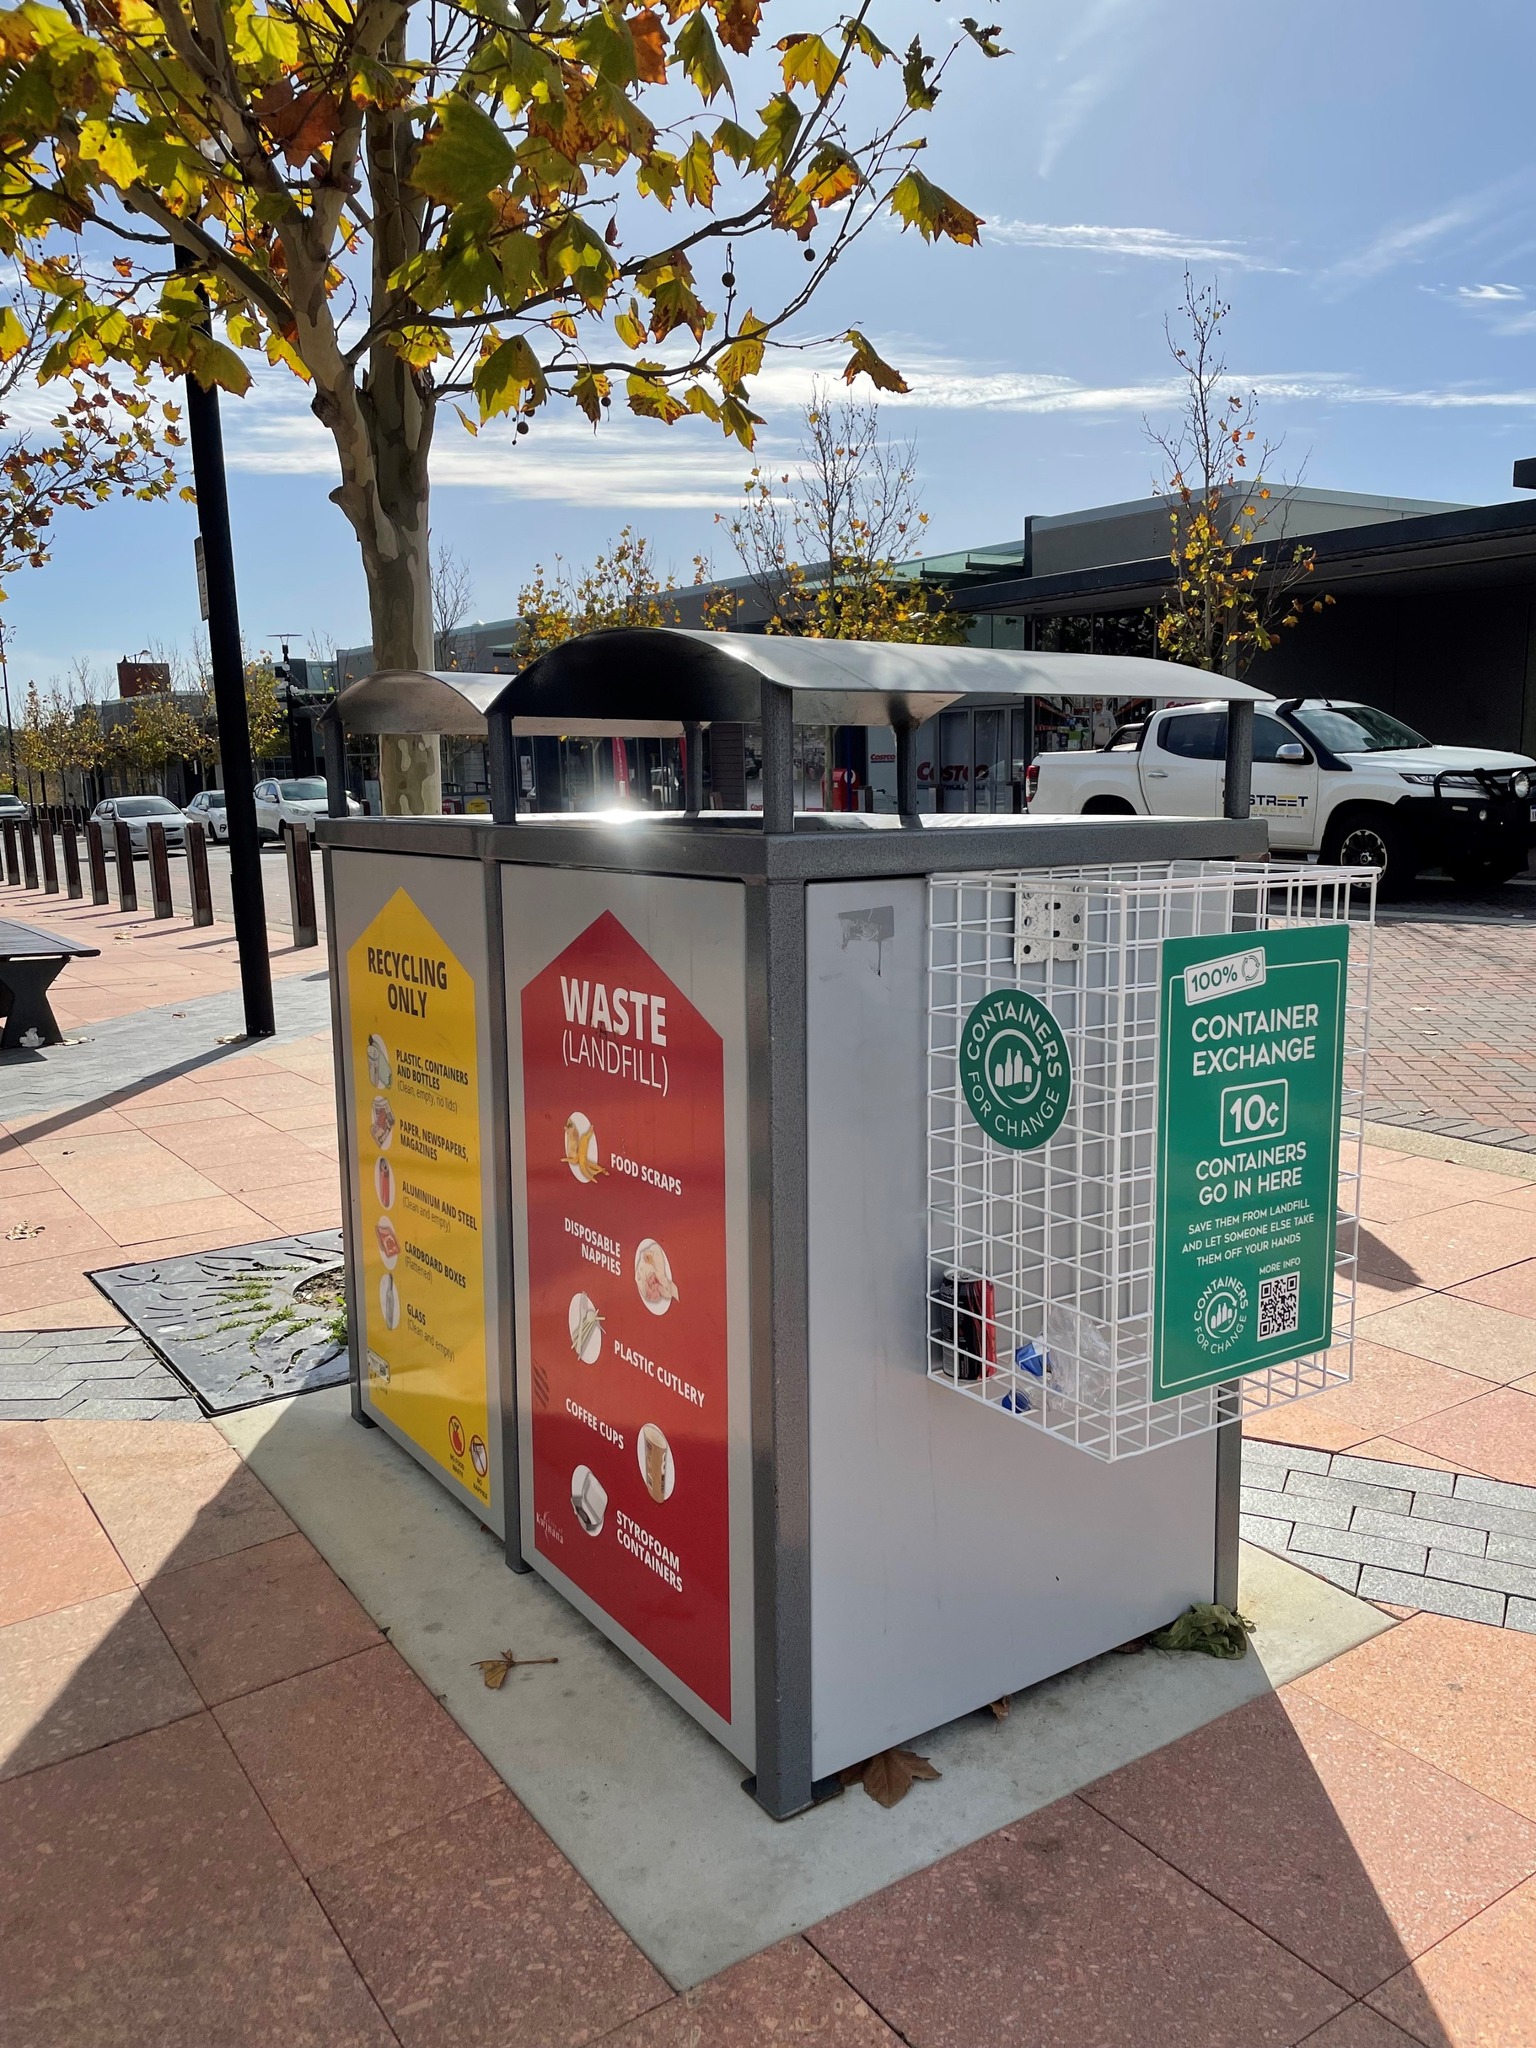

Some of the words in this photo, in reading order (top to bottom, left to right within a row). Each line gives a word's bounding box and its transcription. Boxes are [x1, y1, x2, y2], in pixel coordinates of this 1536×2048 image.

[367, 946, 447, 990] RECYCLING
[1191, 963, 1238, 993] 100%
[387, 983, 427, 1019] ONLY
[560, 975, 667, 1047] WASTE
[967, 1001, 1062, 1078] CONTAINERS
[1191, 1003, 1319, 1043] CONTAINER
[396, 1049, 424, 1072] PLASTIC,
[424, 1059, 469, 1086] CONTAINERS
[562, 1029, 669, 1097] (LANDFILL)
[1192, 1035, 1317, 1077] EXCHANGE
[397, 1064, 411, 1080] AND
[412, 1069, 440, 1090] BOTTLES
[436, 1096, 444, 1108] no
[967, 1071, 992, 1118] FOR
[994, 1087, 1060, 1137] CHANGE
[400, 1119, 421, 1141] PAPER,
[422, 1128, 469, 1162] NEWSPAPERS,
[400, 1134, 438, 1161] MAGAZINES
[1195, 1141, 1307, 1181] CONTAINERS
[610, 1152, 639, 1178] FOOD
[641, 1165, 682, 1196] SCRAPS
[1199, 1182, 1228, 1206] GO
[1233, 1177, 1252, 1200] IN
[1257, 1166, 1303, 1194] HERE
[402, 1180, 441, 1211] ALUMINIUM
[441, 1201, 457, 1219] AND
[457, 1209, 478, 1231] STEEL
[1188, 1220, 1212, 1235] SAVE
[1215, 1214, 1240, 1229] THEM
[1242, 1208, 1268, 1223] FROM
[1269, 1198, 1310, 1216] LANDFILL
[564, 1217, 621, 1258] DISPOSABLE
[1181, 1240, 1203, 1254] AND
[1205, 1235, 1222, 1248] LET
[1224, 1224, 1268, 1244] SOMEONE
[1270, 1218, 1292, 1232] ELSE
[1294, 1213, 1315, 1227] TAKE
[1196, 1252, 1222, 1267] THEM
[1224, 1246, 1243, 1260] OFF
[1244, 1240, 1269, 1255] YOUR
[1271, 1232, 1301, 1249] HANDS
[404, 1241, 443, 1274] CARDBOARD
[444, 1265, 466, 1289] BOXES
[581, 1243, 621, 1277] NAPPIES
[1259, 1261, 1281, 1275] MORE
[1283, 1257, 1301, 1269] INFO
[406, 1303, 426, 1326] GLASS
[1193, 1275, 1249, 1321] CONTAINERS
[1194, 1326, 1210, 1351] FOR
[1210, 1315, 1248, 1354] CHANGE
[614, 1339, 655, 1378] PLASTIC
[657, 1366, 705, 1408] CUTLERY
[565, 1397, 598, 1432] COFFEE
[599, 1421, 624, 1450] CUPS
[616, 1510, 680, 1573] STYROFOAM
[616, 1528, 683, 1593] CONTAINERS
